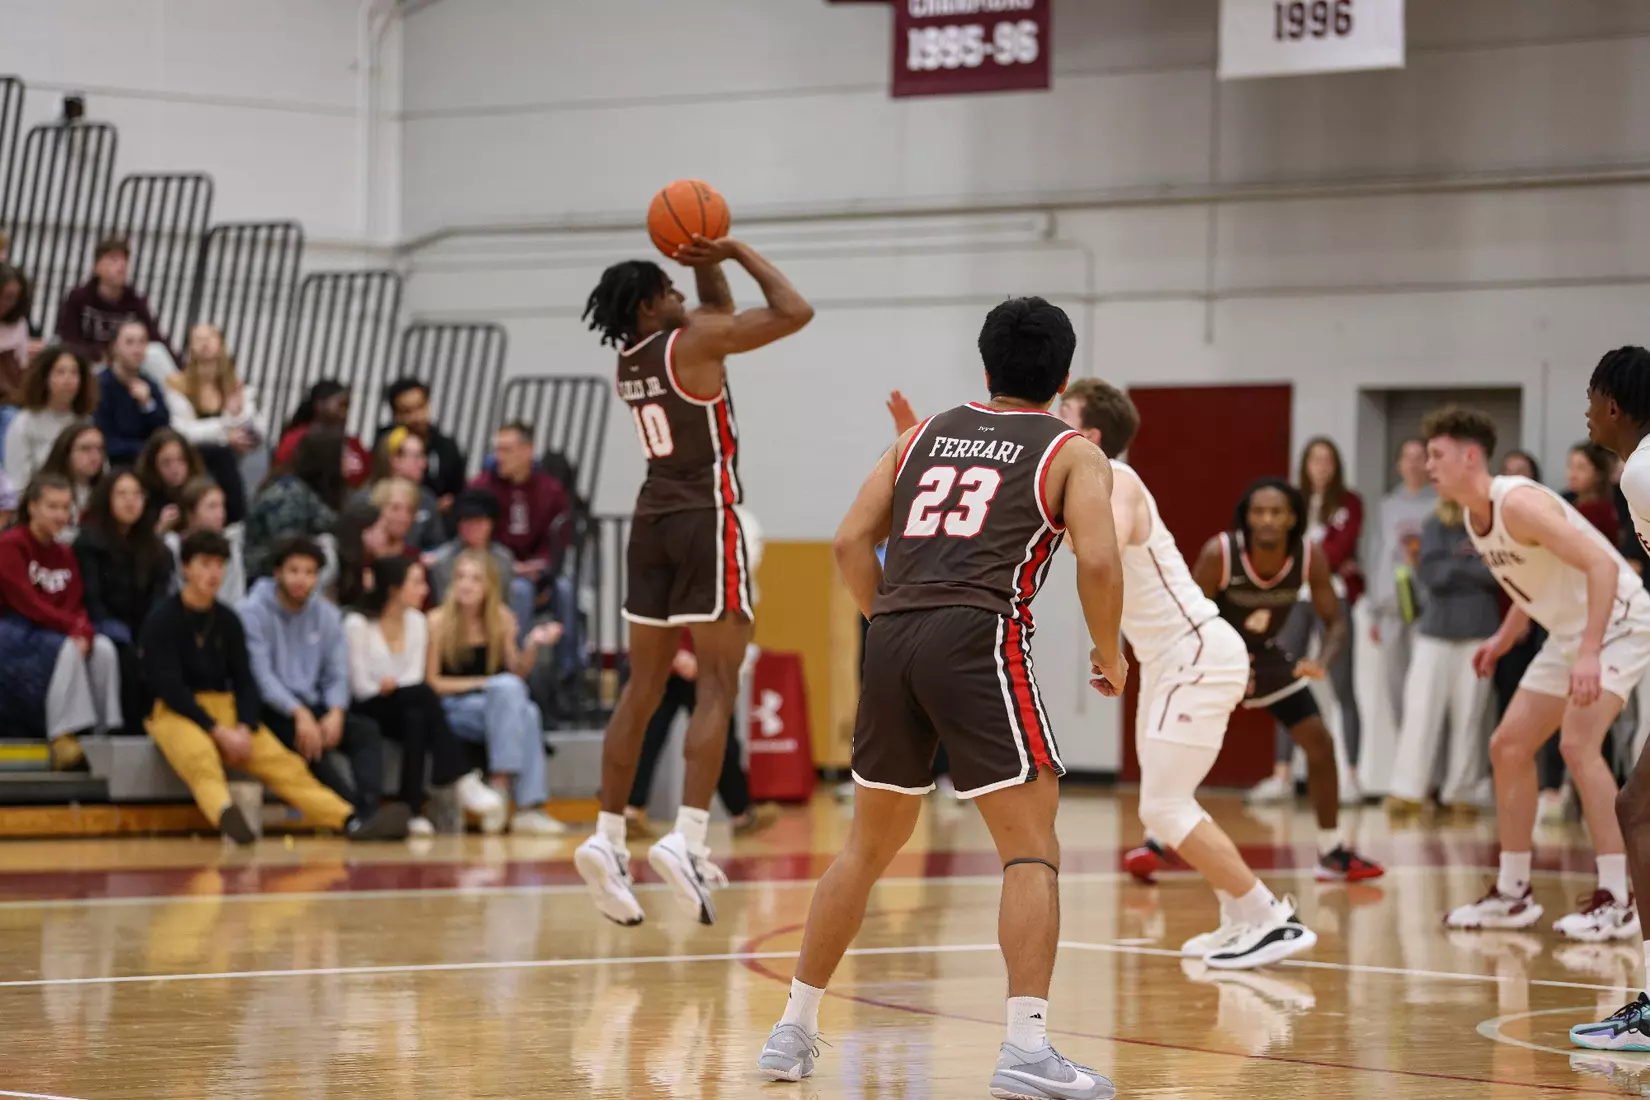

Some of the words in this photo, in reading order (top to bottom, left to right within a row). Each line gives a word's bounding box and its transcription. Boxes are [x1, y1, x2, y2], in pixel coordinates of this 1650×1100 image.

[1275, 0, 1352, 39] 1996
[907, 20, 1038, 70] 1995-96
[631, 403, 674, 459] 10
[929, 436, 1024, 464] FERRARI
[902, 465, 1003, 539] 23
